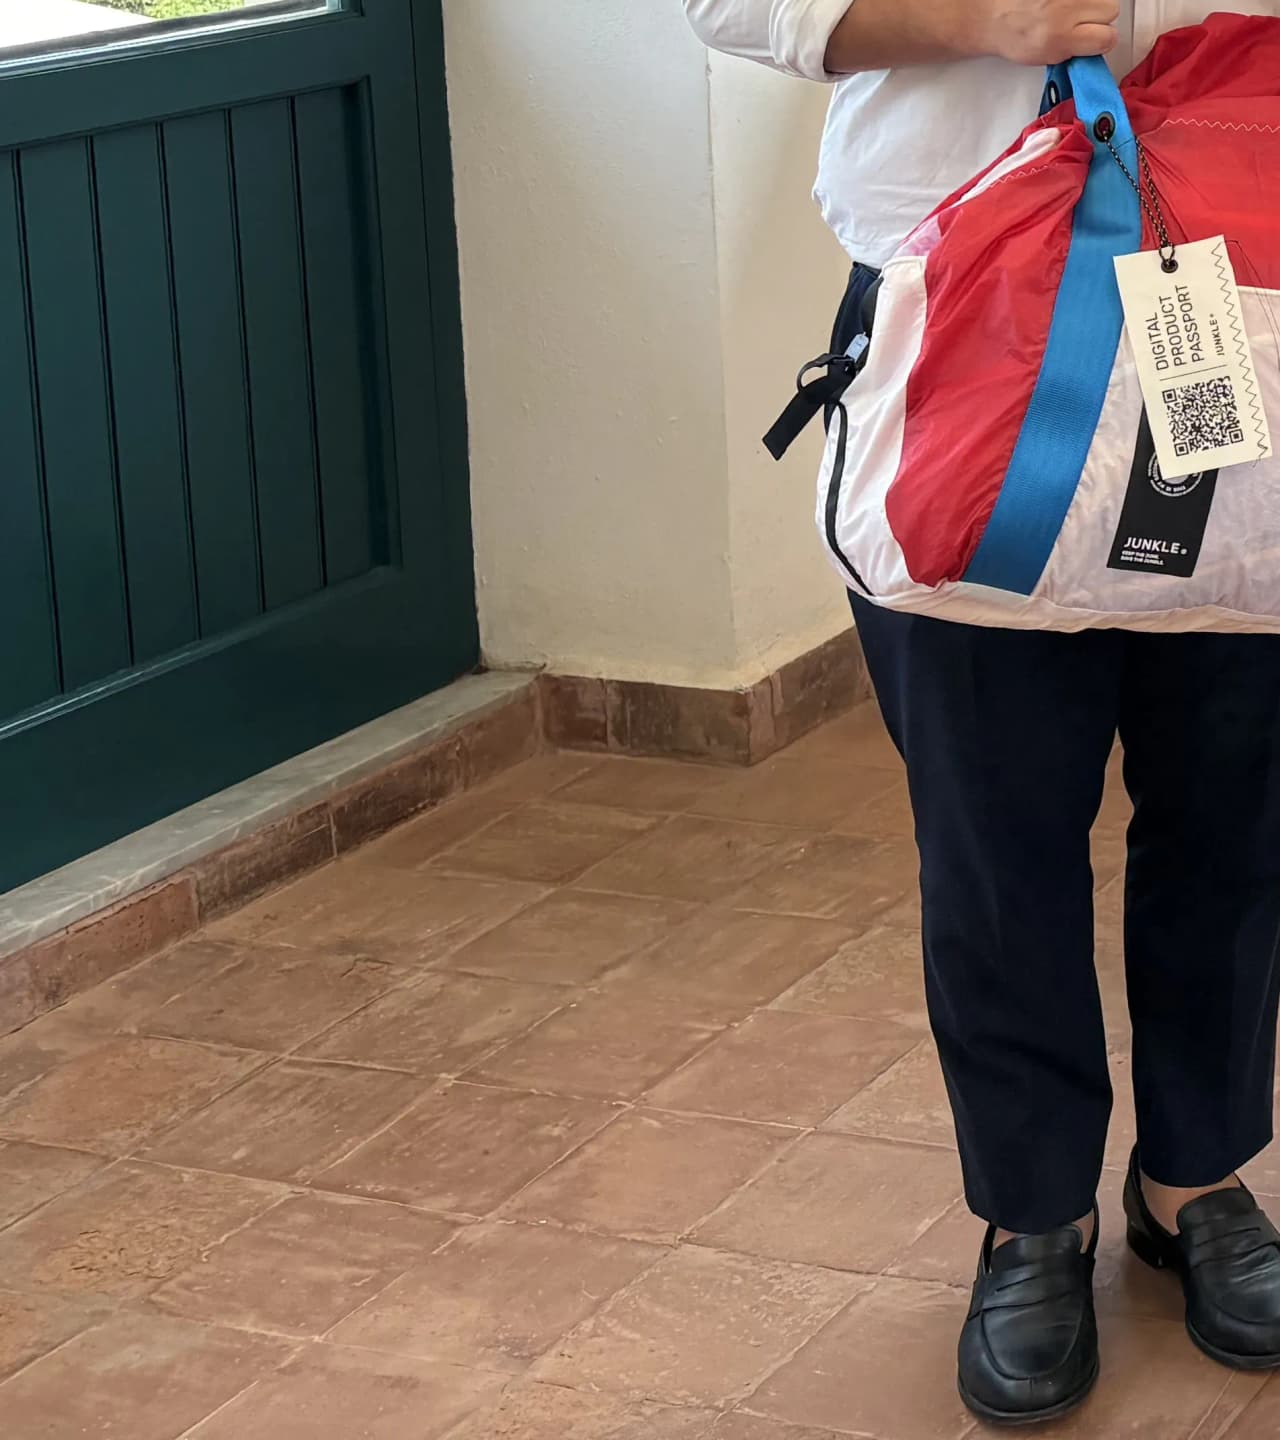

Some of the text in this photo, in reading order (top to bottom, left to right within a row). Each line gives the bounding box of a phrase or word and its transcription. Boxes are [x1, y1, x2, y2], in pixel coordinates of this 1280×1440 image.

[1145, 312, 1170, 371] DIGITAL
[1159, 295, 1188, 367] PRODUCT
[1175, 284, 1205, 363] PASSPORT
